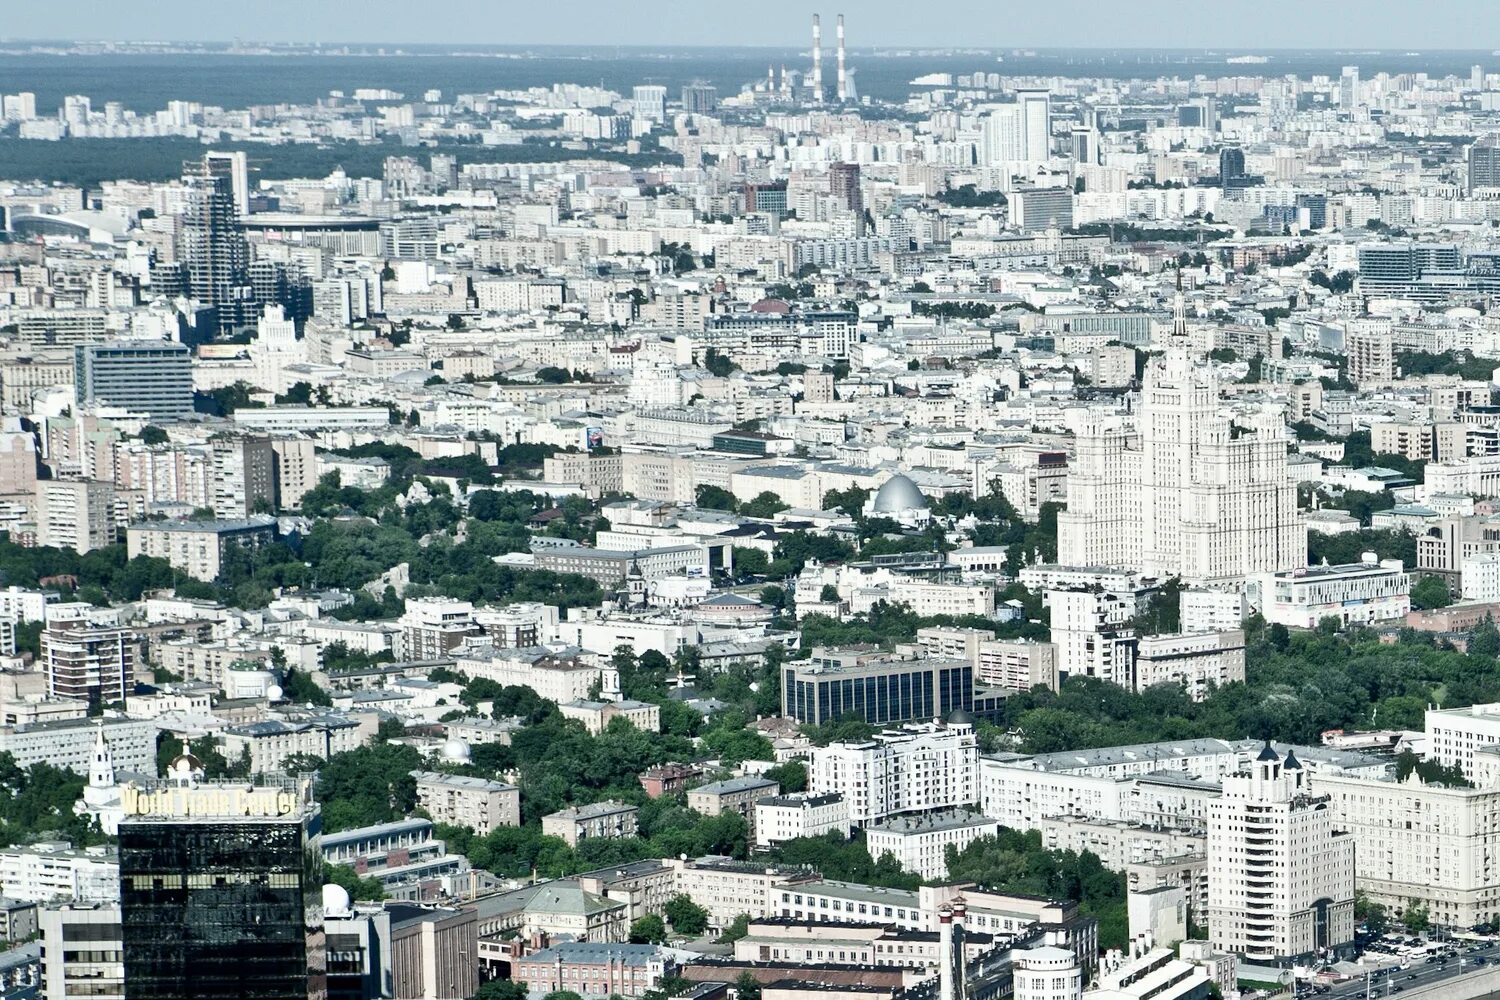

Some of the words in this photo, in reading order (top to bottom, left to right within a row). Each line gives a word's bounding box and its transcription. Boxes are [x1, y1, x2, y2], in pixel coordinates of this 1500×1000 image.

[122, 787, 174, 815] World
[180, 787, 230, 815] Trade
[237, 787, 297, 817] Center
